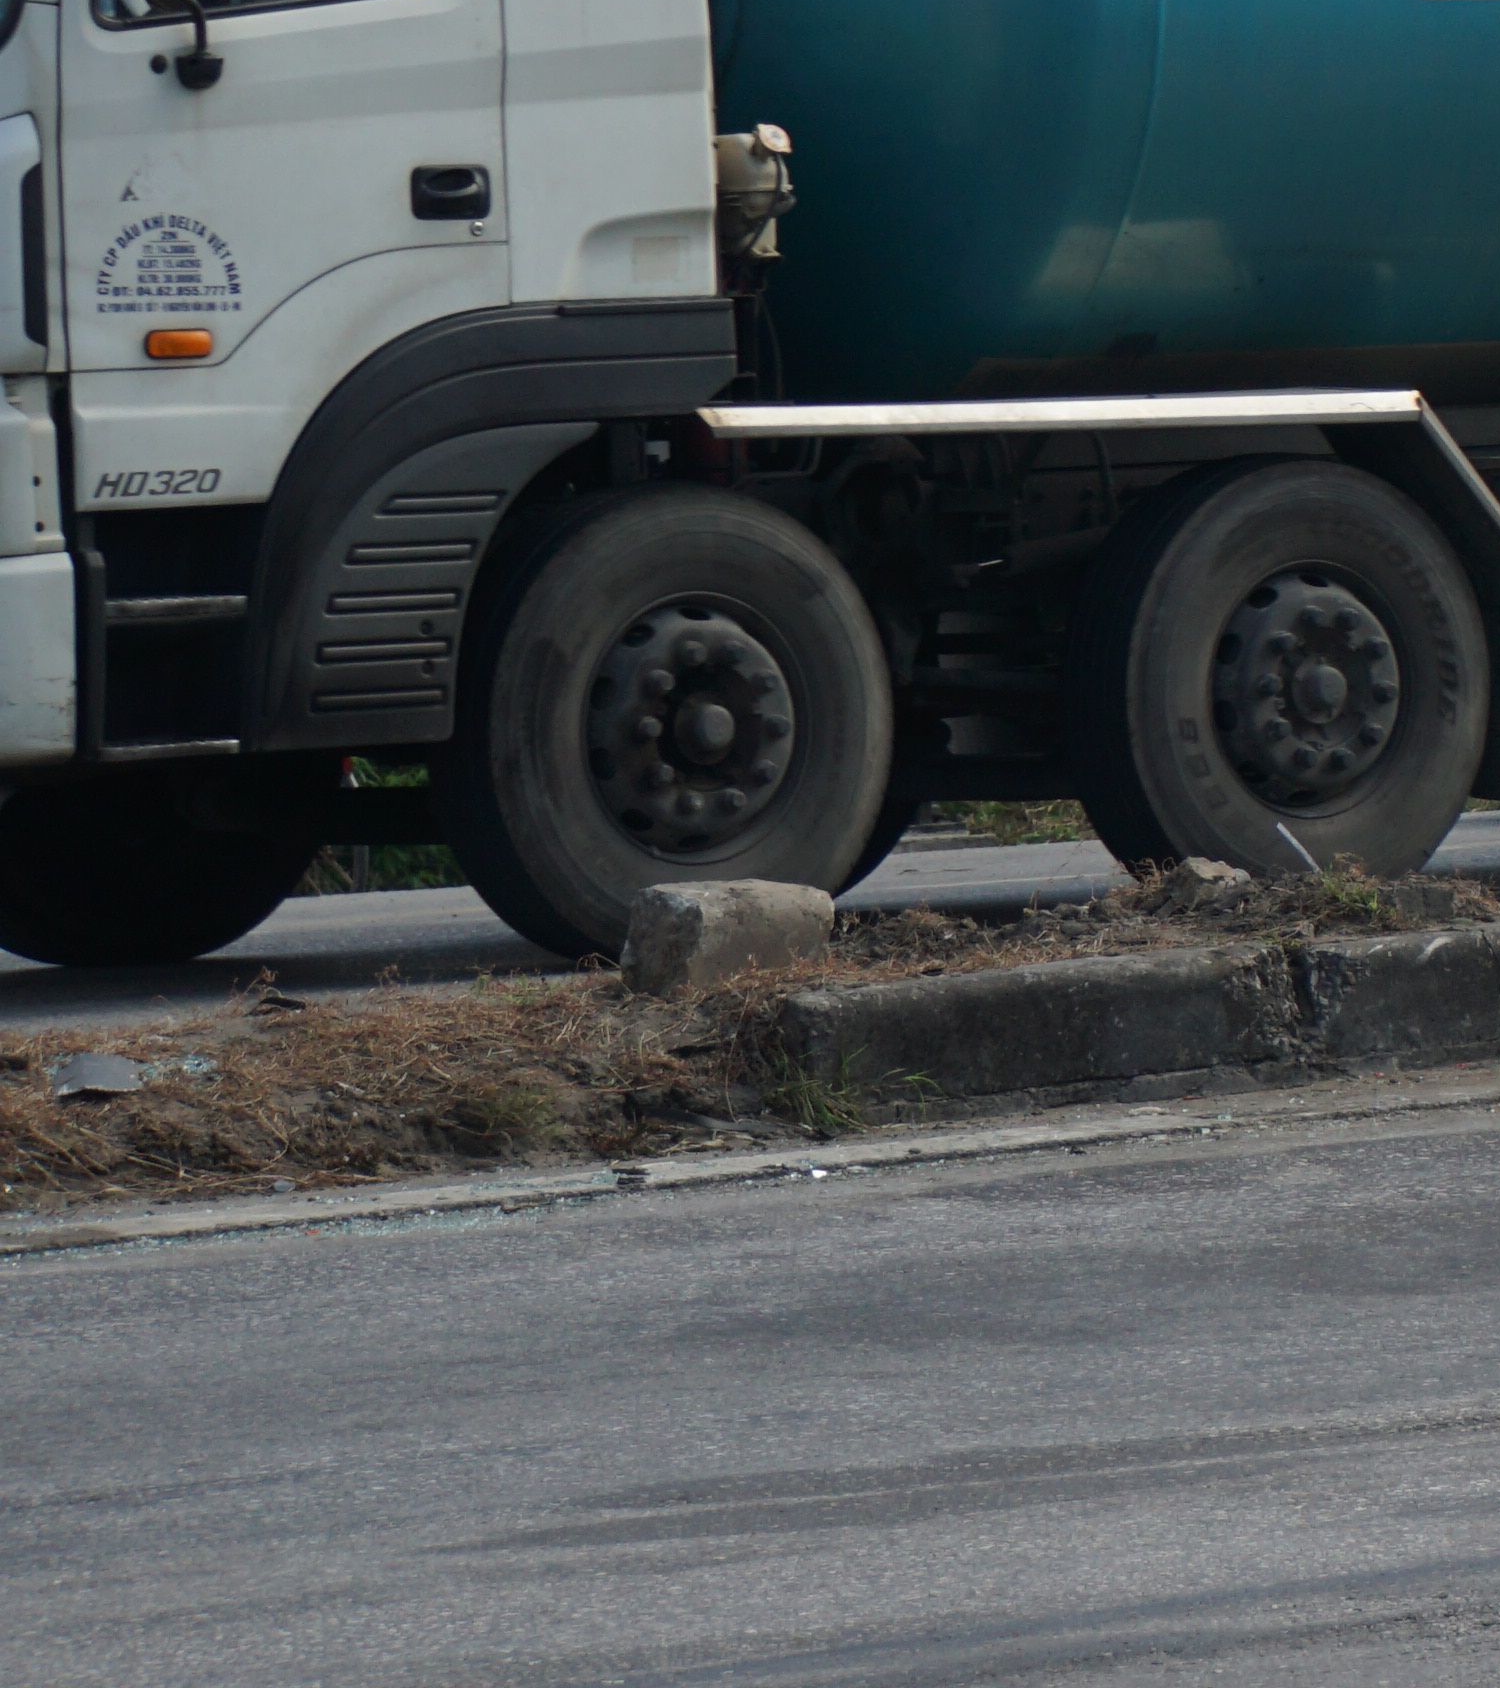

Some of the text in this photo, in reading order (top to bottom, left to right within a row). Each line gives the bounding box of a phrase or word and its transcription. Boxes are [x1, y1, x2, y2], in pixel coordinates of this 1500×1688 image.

[168, 214, 207, 238] DELTA
[103, 247, 119, 267] CP
[97, 269, 112, 296] CTY
[224, 261, 241, 295] NAM
[94, 468, 222, 499] HD320
